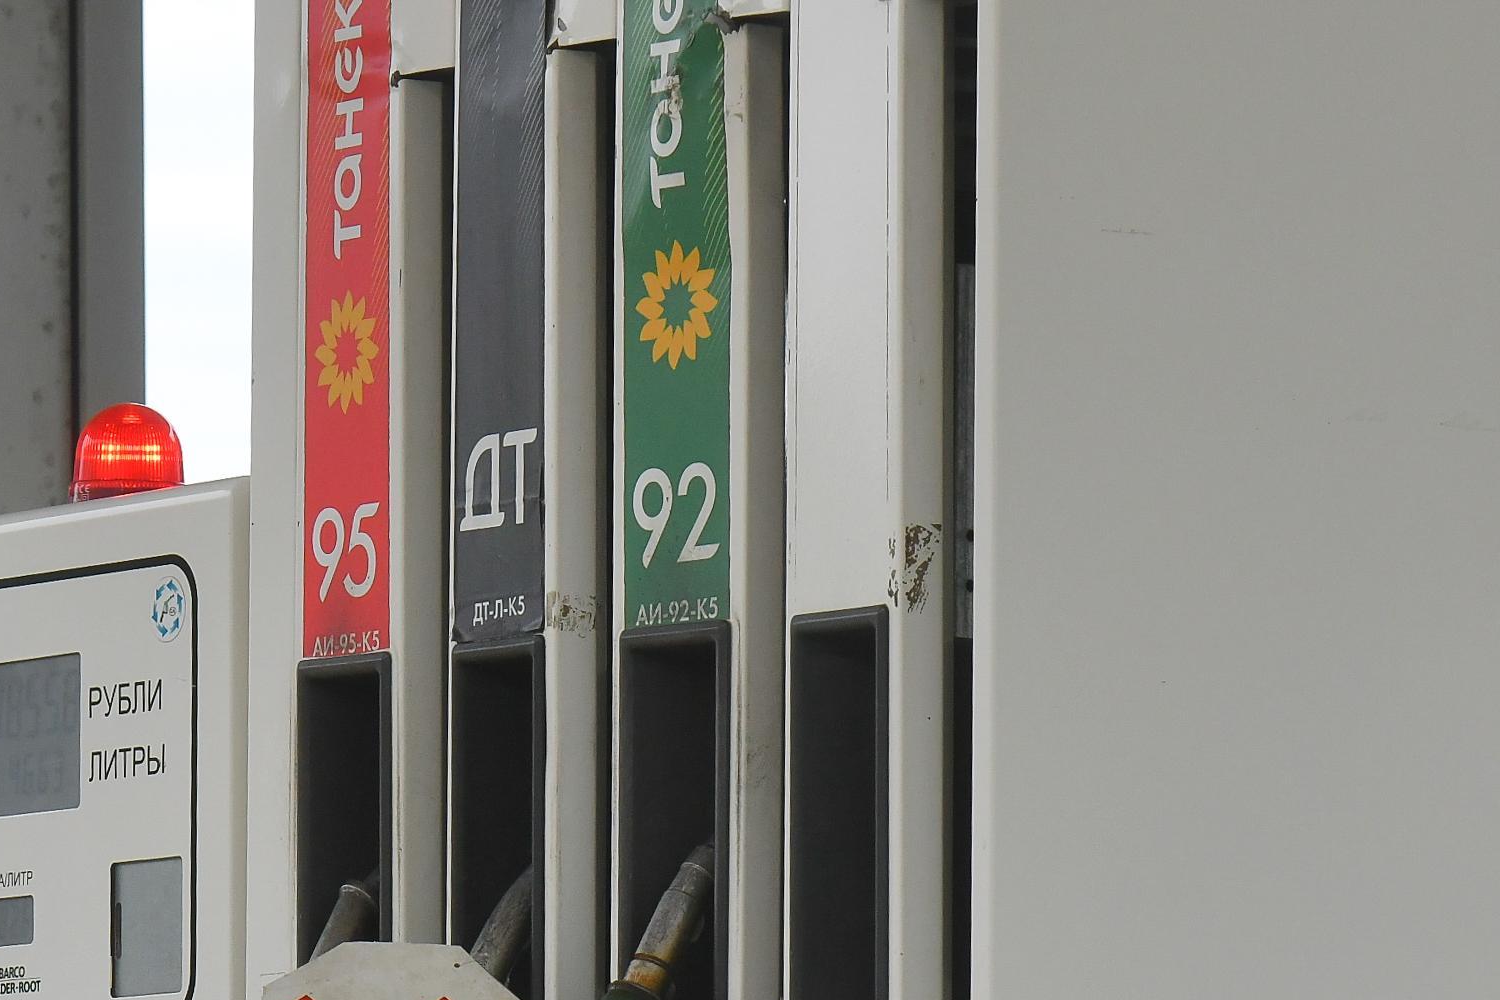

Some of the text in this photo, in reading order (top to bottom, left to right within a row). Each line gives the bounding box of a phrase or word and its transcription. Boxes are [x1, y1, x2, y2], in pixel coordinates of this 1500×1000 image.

[460, 428, 537, 532] ДТ
[632, 462, 720, 569] 92
[312, 502, 379, 602] 95
[472, 595, 526, 627] ДТ-Л-К5
[635, 597, 719, 626] АИ-92-К5
[313, 630, 380, 657] АИ-95-К5
[89, 679, 162, 718] РУБЛИ
[89, 744, 165, 782] ЛИТРЫ
